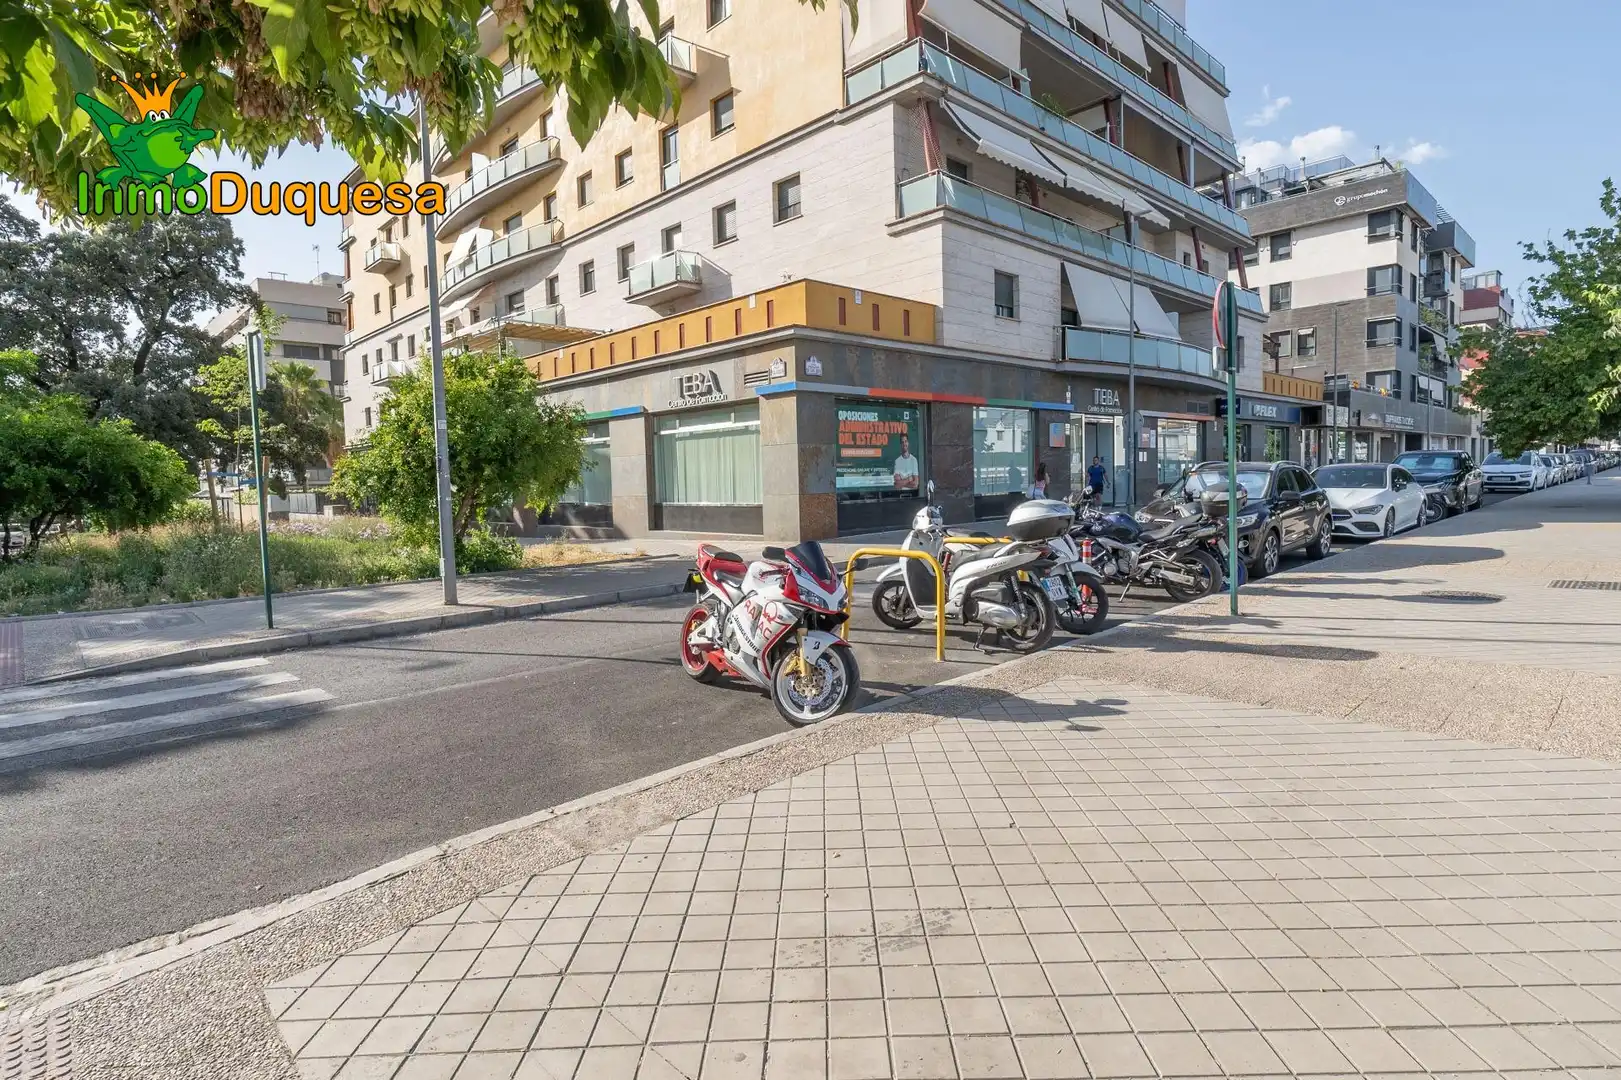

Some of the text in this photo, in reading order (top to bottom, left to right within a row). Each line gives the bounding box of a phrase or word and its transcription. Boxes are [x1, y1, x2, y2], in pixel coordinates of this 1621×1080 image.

[672, 369, 719, 398] TEBA
[667, 399, 687, 408] Centro
[687, 398, 696, 406] de
[1094, 388, 1121, 406] TEBA
[838, 410, 879, 422] OPOSICIONES
[838, 420, 908, 434] ADMINISTRATIVO
[839, 432, 889, 446] DEL ESTADO
